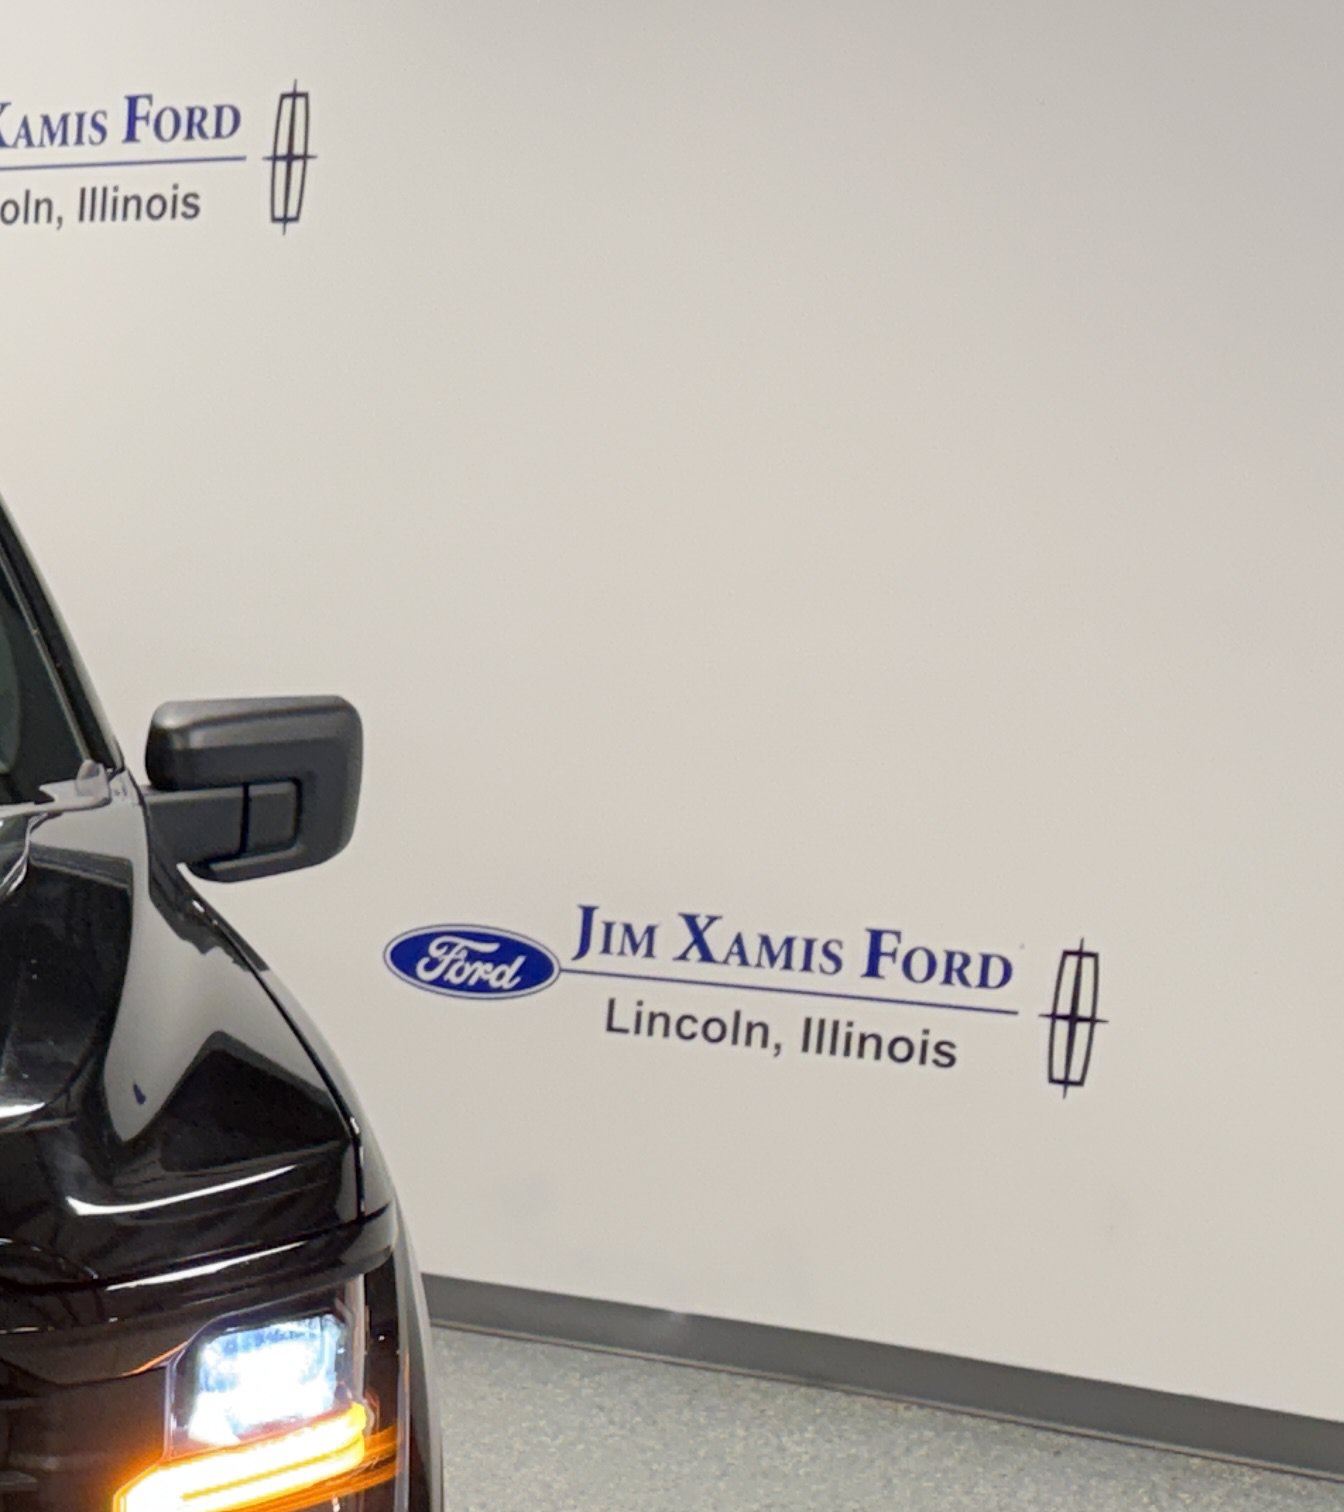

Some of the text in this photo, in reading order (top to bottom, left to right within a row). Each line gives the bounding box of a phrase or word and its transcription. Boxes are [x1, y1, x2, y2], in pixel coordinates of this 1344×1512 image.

[122, 94, 241, 144] FORD
[78, 183, 201, 223] Illinois
[416, 934, 523, 990] Ford
[572, 904, 1013, 990] JIM XAMIS FORD
[605, 998, 957, 1069] Lincoln, Illinois
